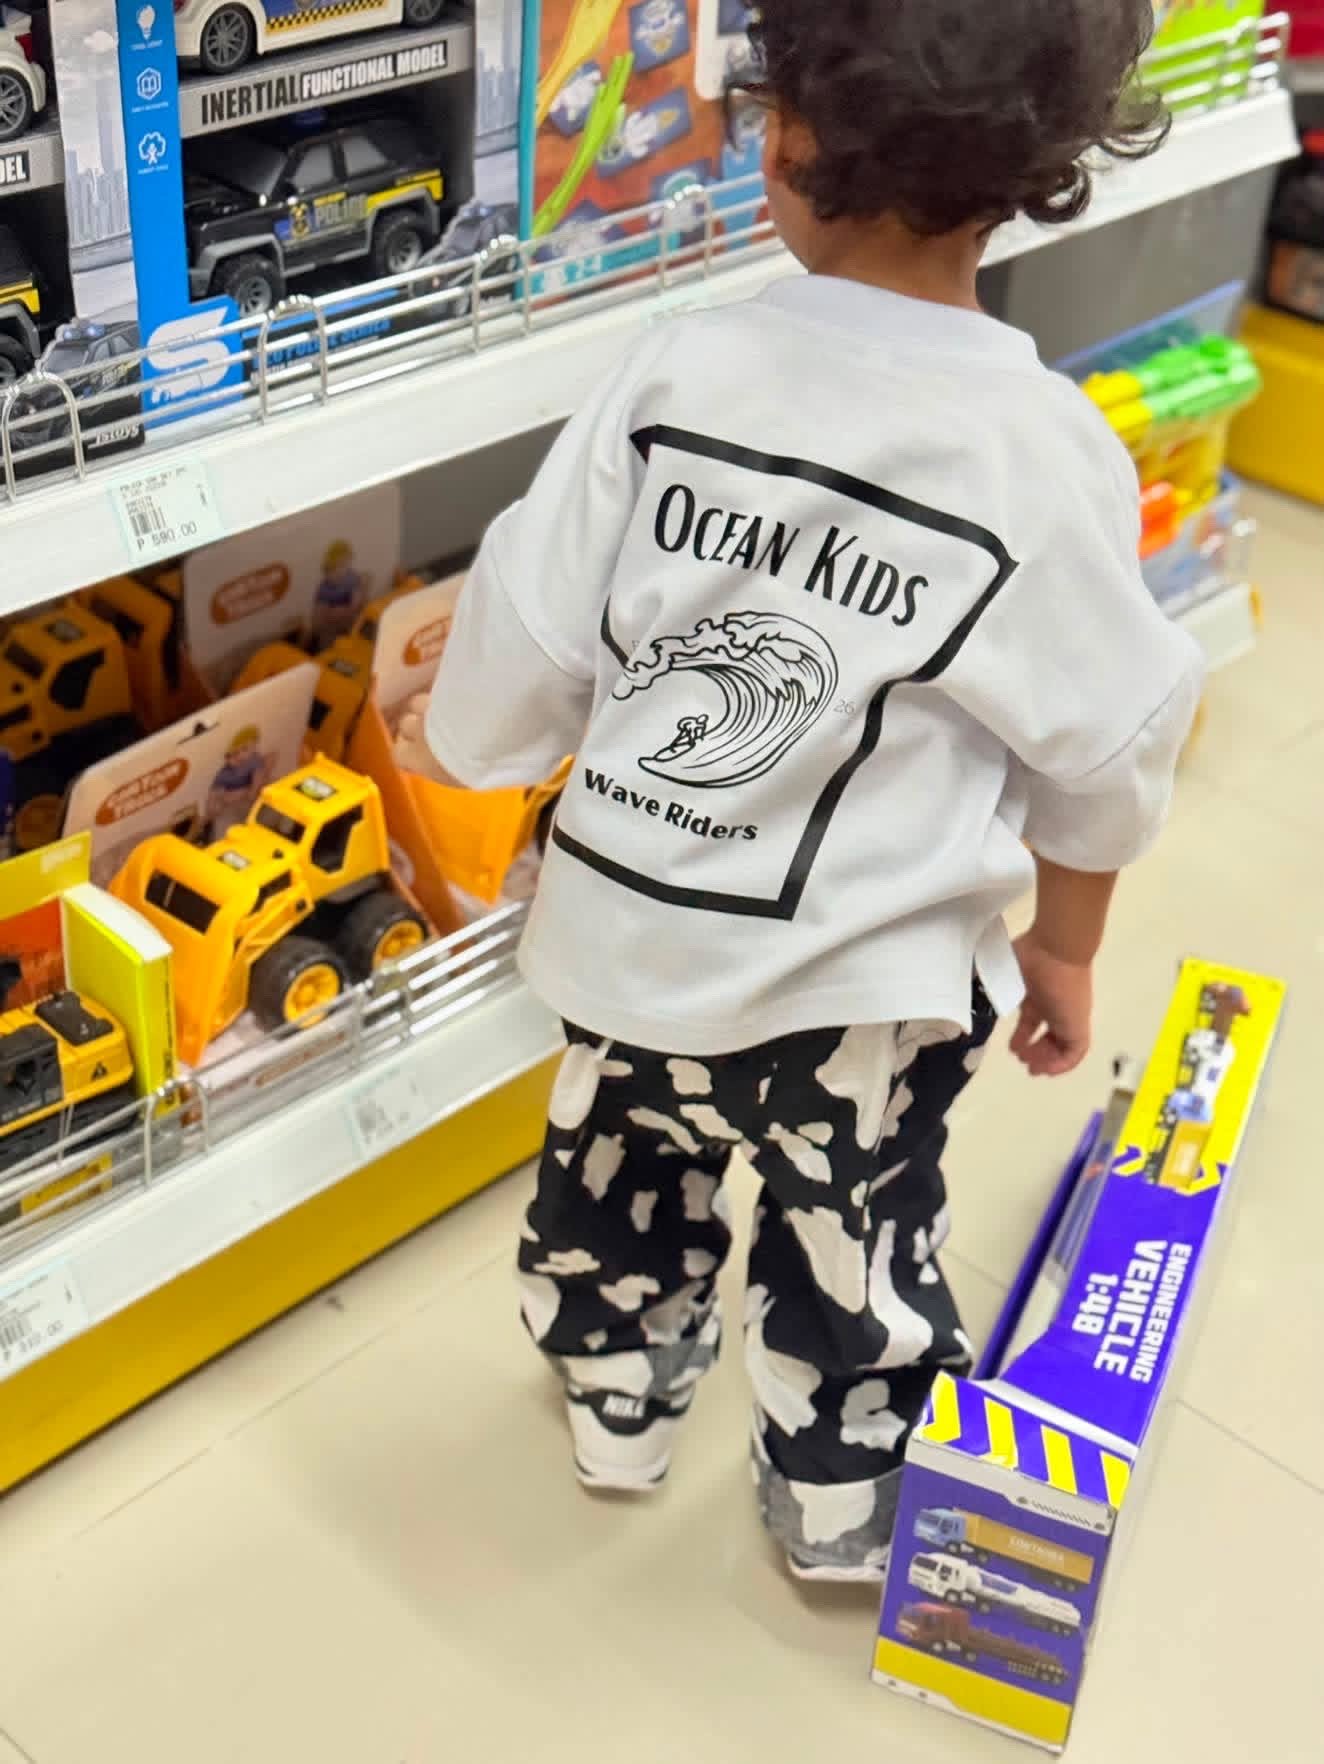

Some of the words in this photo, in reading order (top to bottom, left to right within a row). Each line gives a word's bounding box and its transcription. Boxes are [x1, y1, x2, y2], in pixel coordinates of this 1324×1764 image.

[201, 76, 298, 125] INERTIAL
[302, 53, 395, 98] FUNCTIONAL
[396, 44, 445, 75] MODEL
[585, 768, 661, 816] Wave
[664, 801, 758, 840] Riders
[1071, 1272, 1119, 1336] 1:48
[1093, 1240, 1168, 1376] VEHICLE
[1129, 1242, 1193, 1384] ENGINEERING
